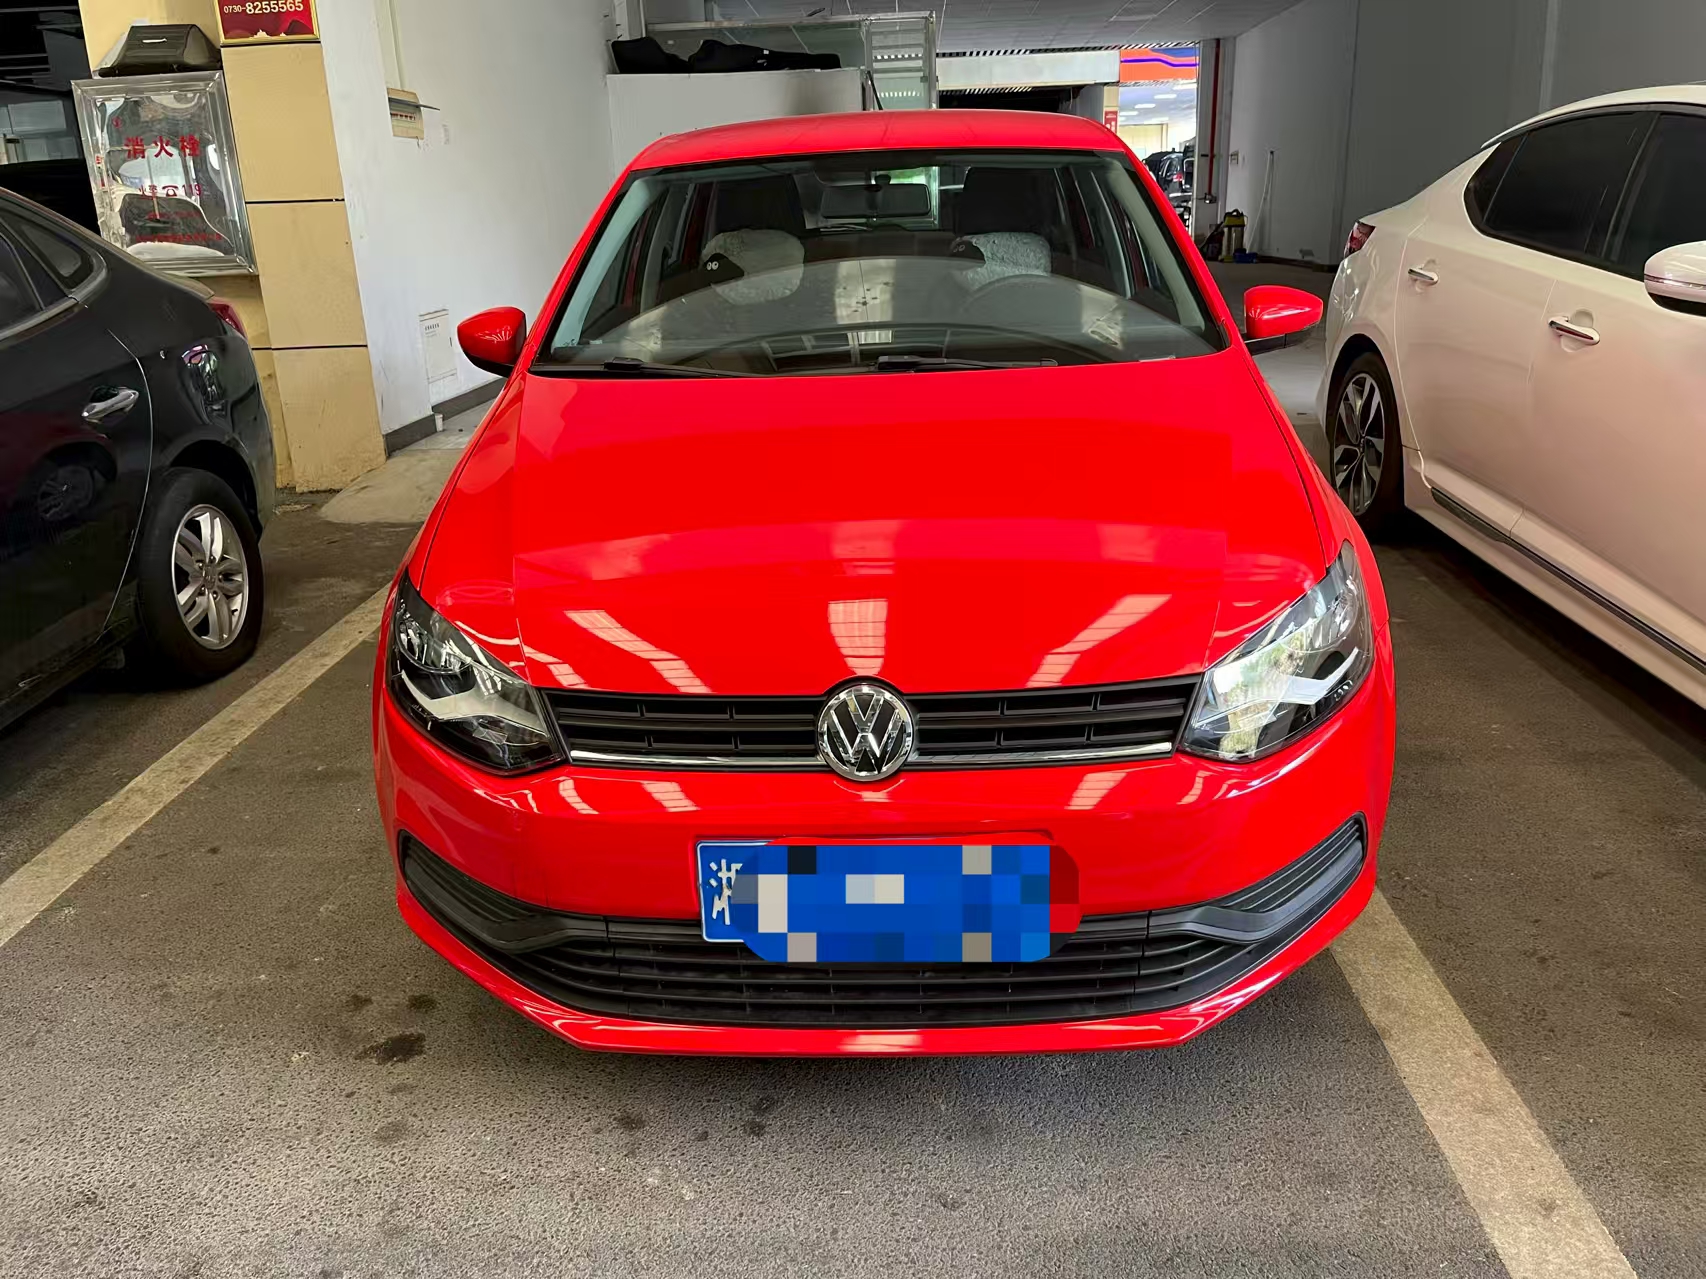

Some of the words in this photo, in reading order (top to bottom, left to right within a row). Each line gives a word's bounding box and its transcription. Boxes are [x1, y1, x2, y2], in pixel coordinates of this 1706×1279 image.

[223, 0, 304, 14] 0730-8255565
[124, 134, 201, 159] 消火栓
